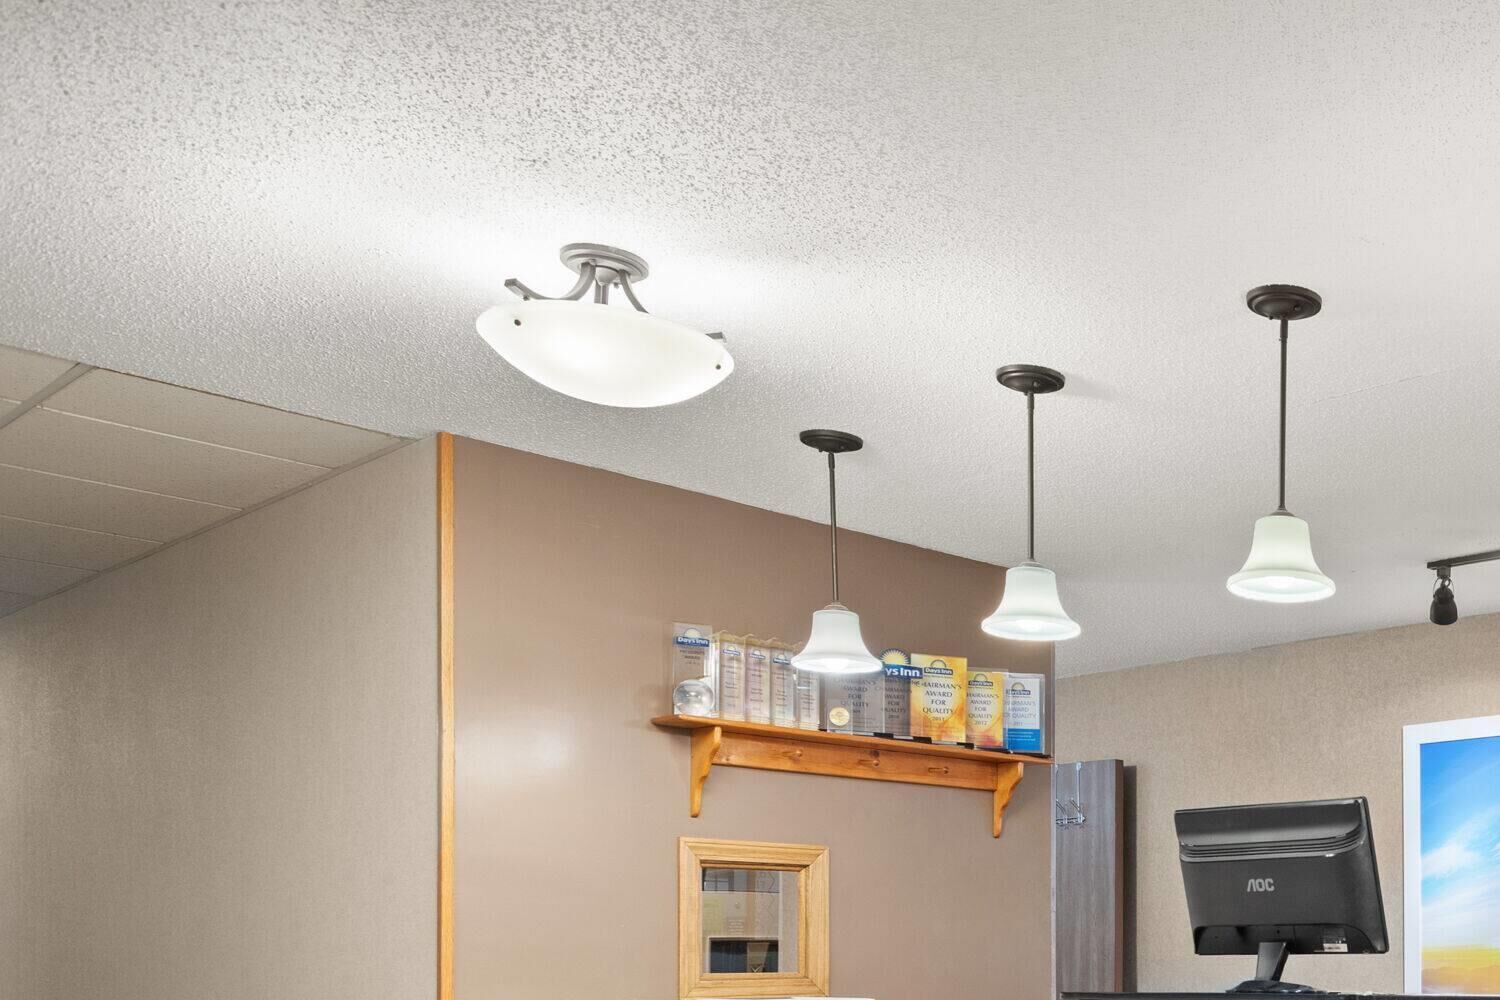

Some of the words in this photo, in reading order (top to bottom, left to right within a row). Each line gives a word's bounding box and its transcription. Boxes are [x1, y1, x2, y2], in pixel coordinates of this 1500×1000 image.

[885, 667, 899, 676] ys
[900, 667, 921, 677] Inn
[925, 690, 952, 698] AWARD
[923, 706, 954, 715] QUALITY
[1247, 878, 1275, 893] AOC
